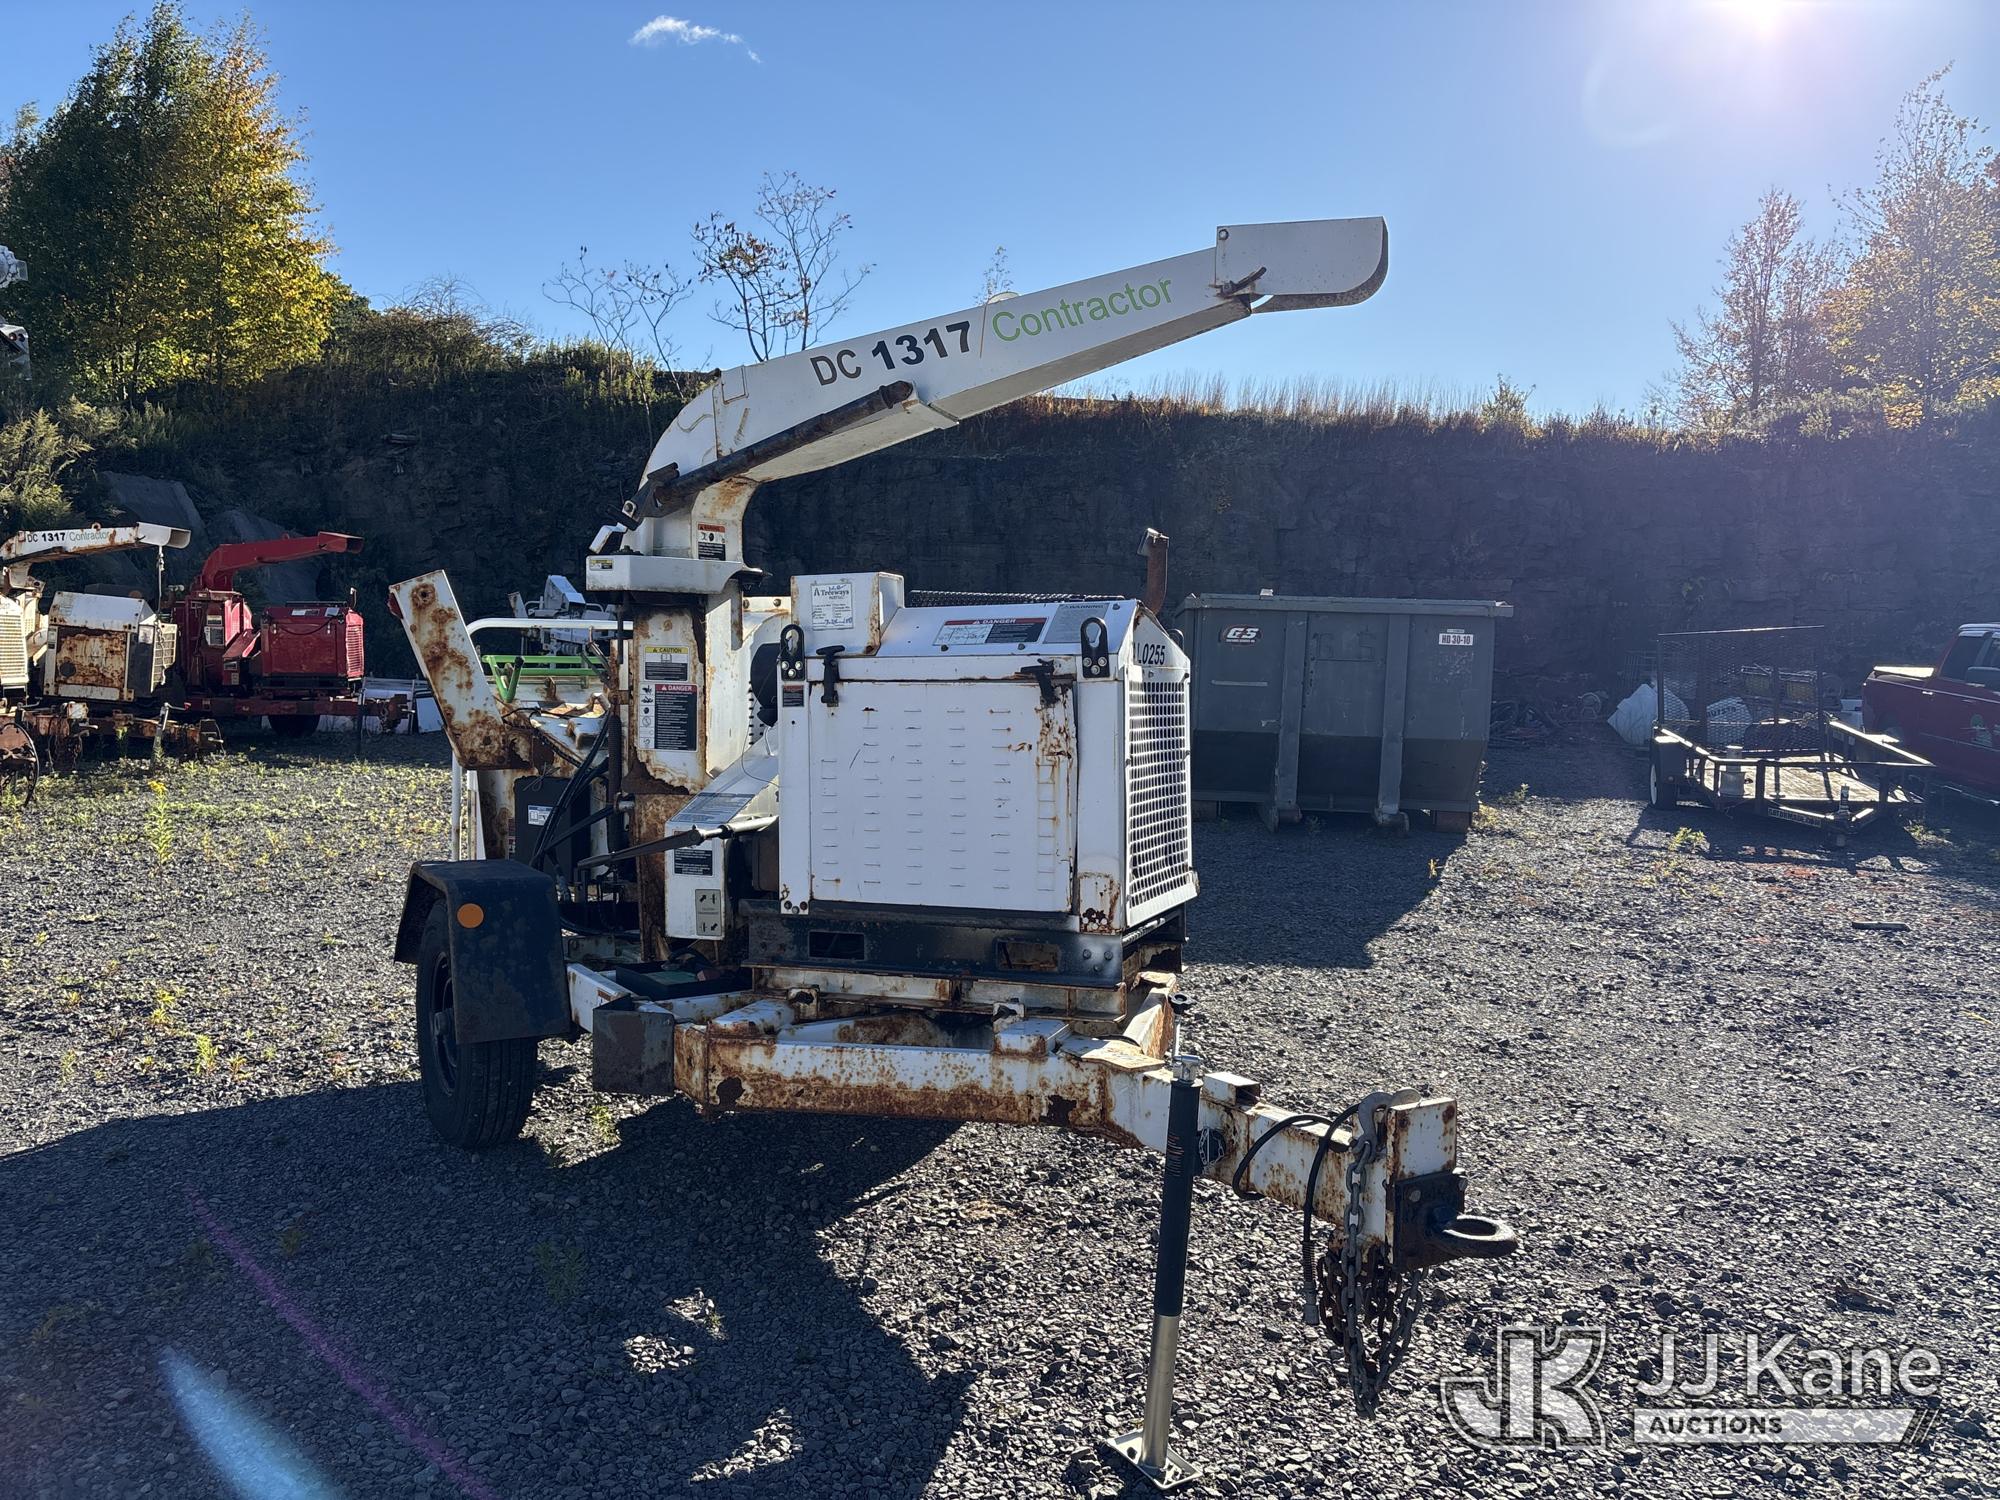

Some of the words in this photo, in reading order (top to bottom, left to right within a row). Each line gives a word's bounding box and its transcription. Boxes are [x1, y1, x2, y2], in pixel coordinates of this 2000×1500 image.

[810, 349, 861, 386] DC
[871, 320, 971, 371] 1317
[992, 279, 1173, 342] Contractor
[27, 534, 39, 542] DC
[41, 532, 66, 542] 1317
[69, 531, 110, 541] Contractor
